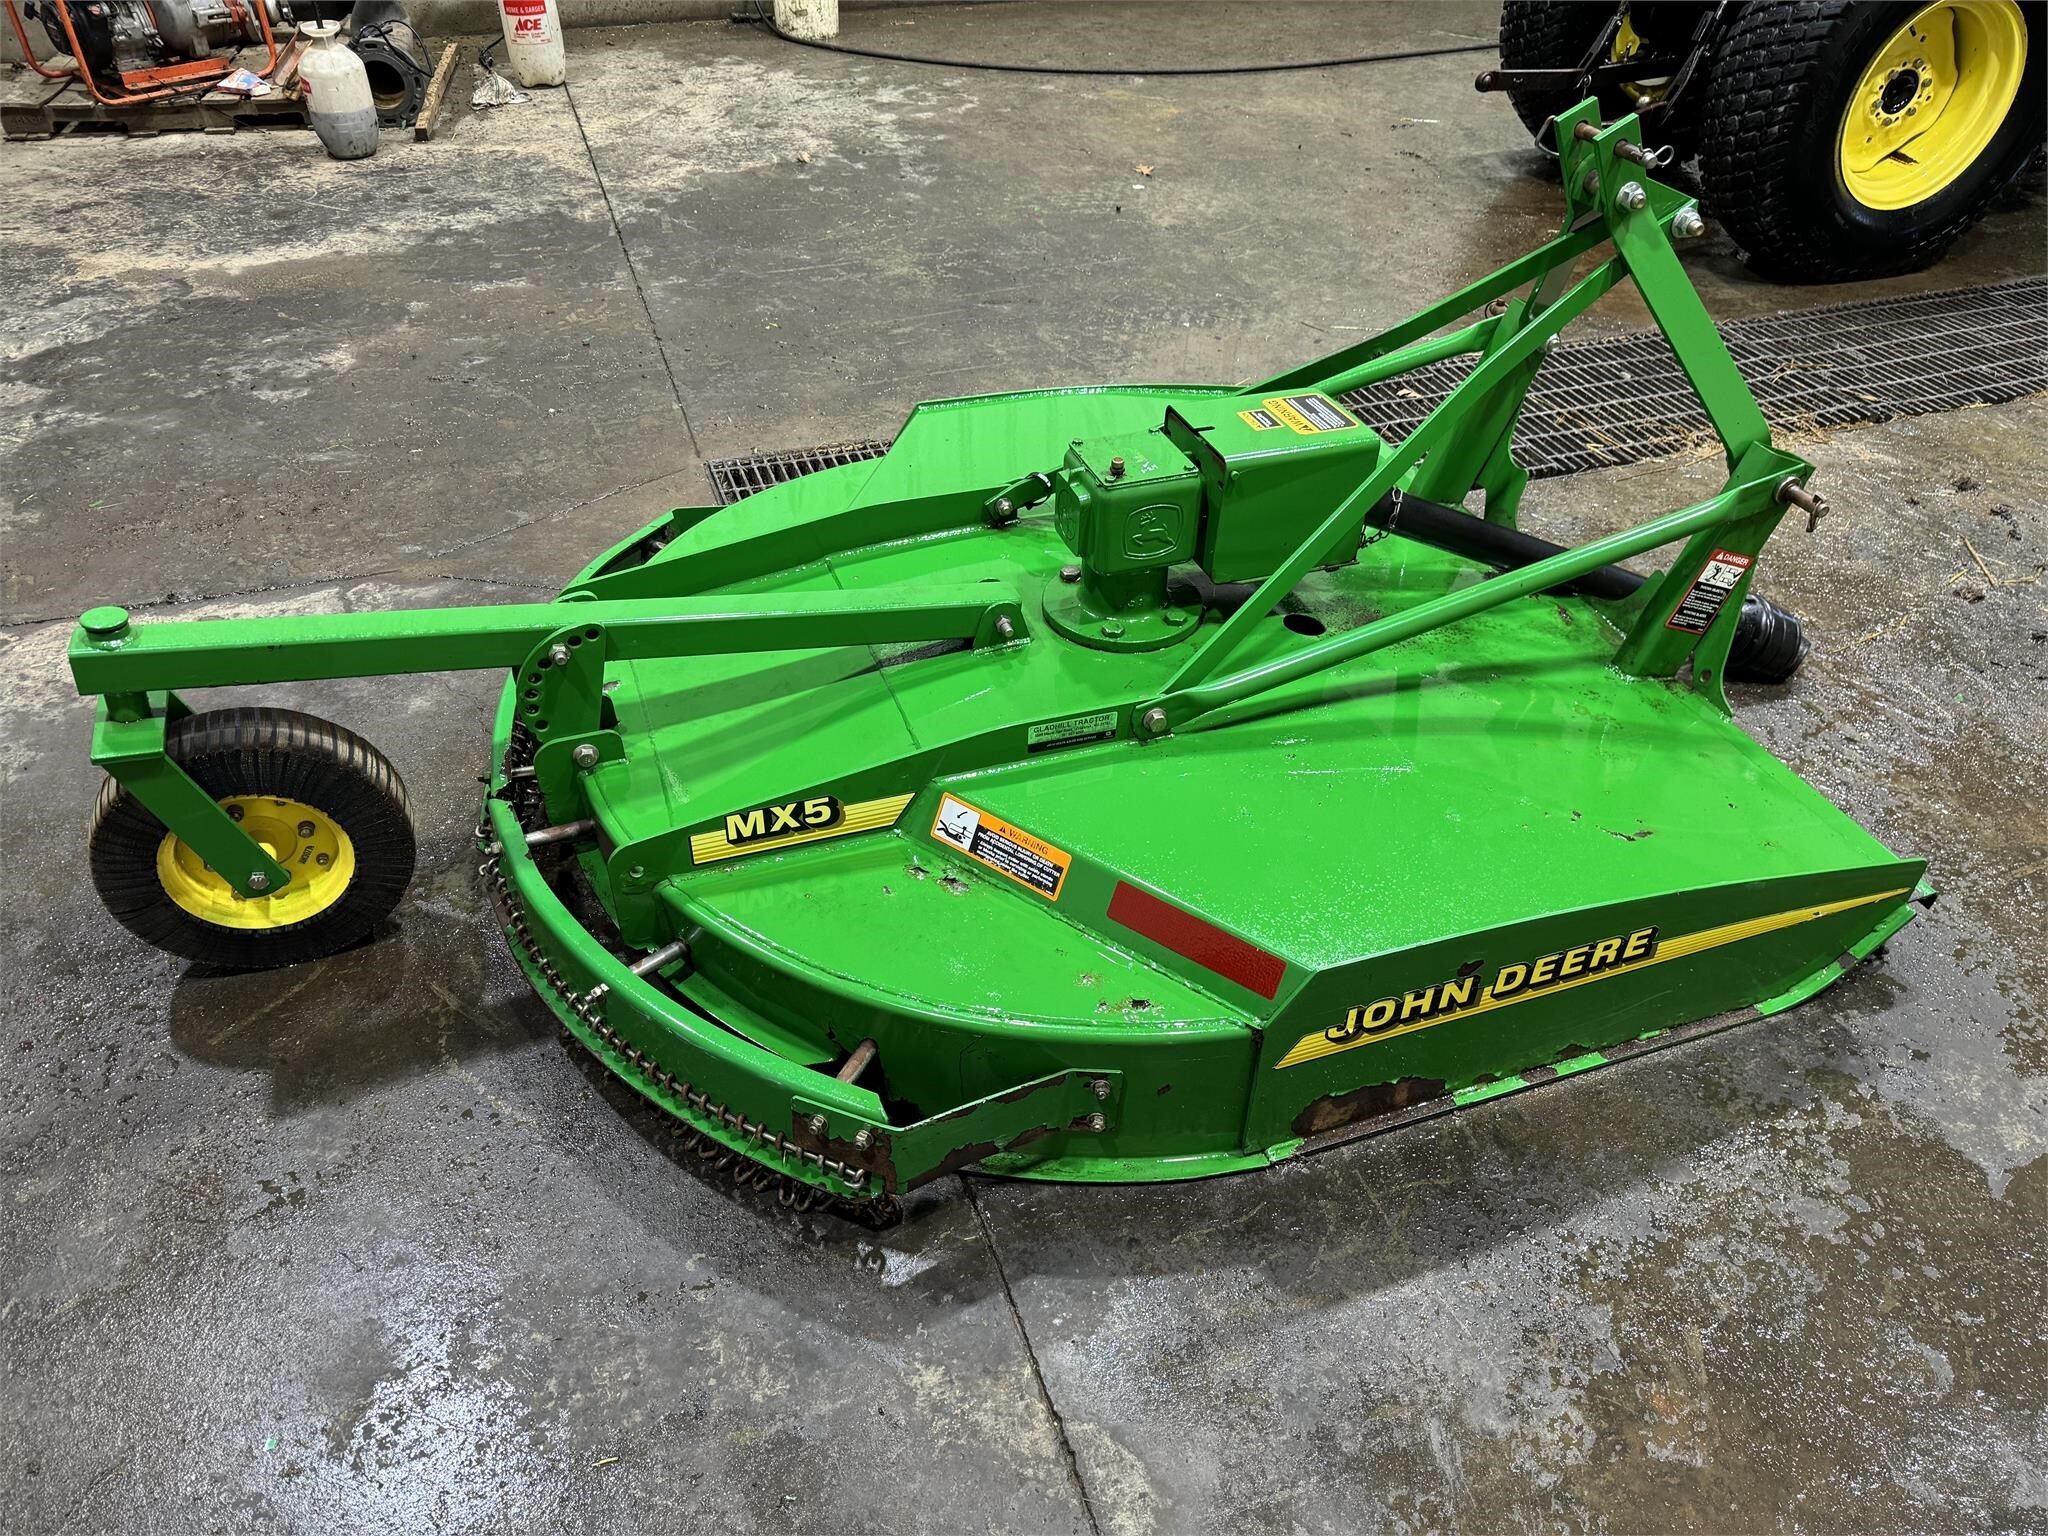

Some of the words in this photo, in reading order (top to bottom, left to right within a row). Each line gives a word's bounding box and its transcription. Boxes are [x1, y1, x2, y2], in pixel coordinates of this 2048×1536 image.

[514, 17, 542, 32] ACE
[1723, 554, 1750, 565] DANGER
[1033, 721, 1072, 733] GLADHILL
[1074, 715, 1110, 726] TRACTOR
[725, 796, 839, 846] MX5
[1008, 828, 1049, 855] WARNING
[1326, 975, 1478, 1043] JOHN
[1490, 925, 1659, 1000] DEERE
